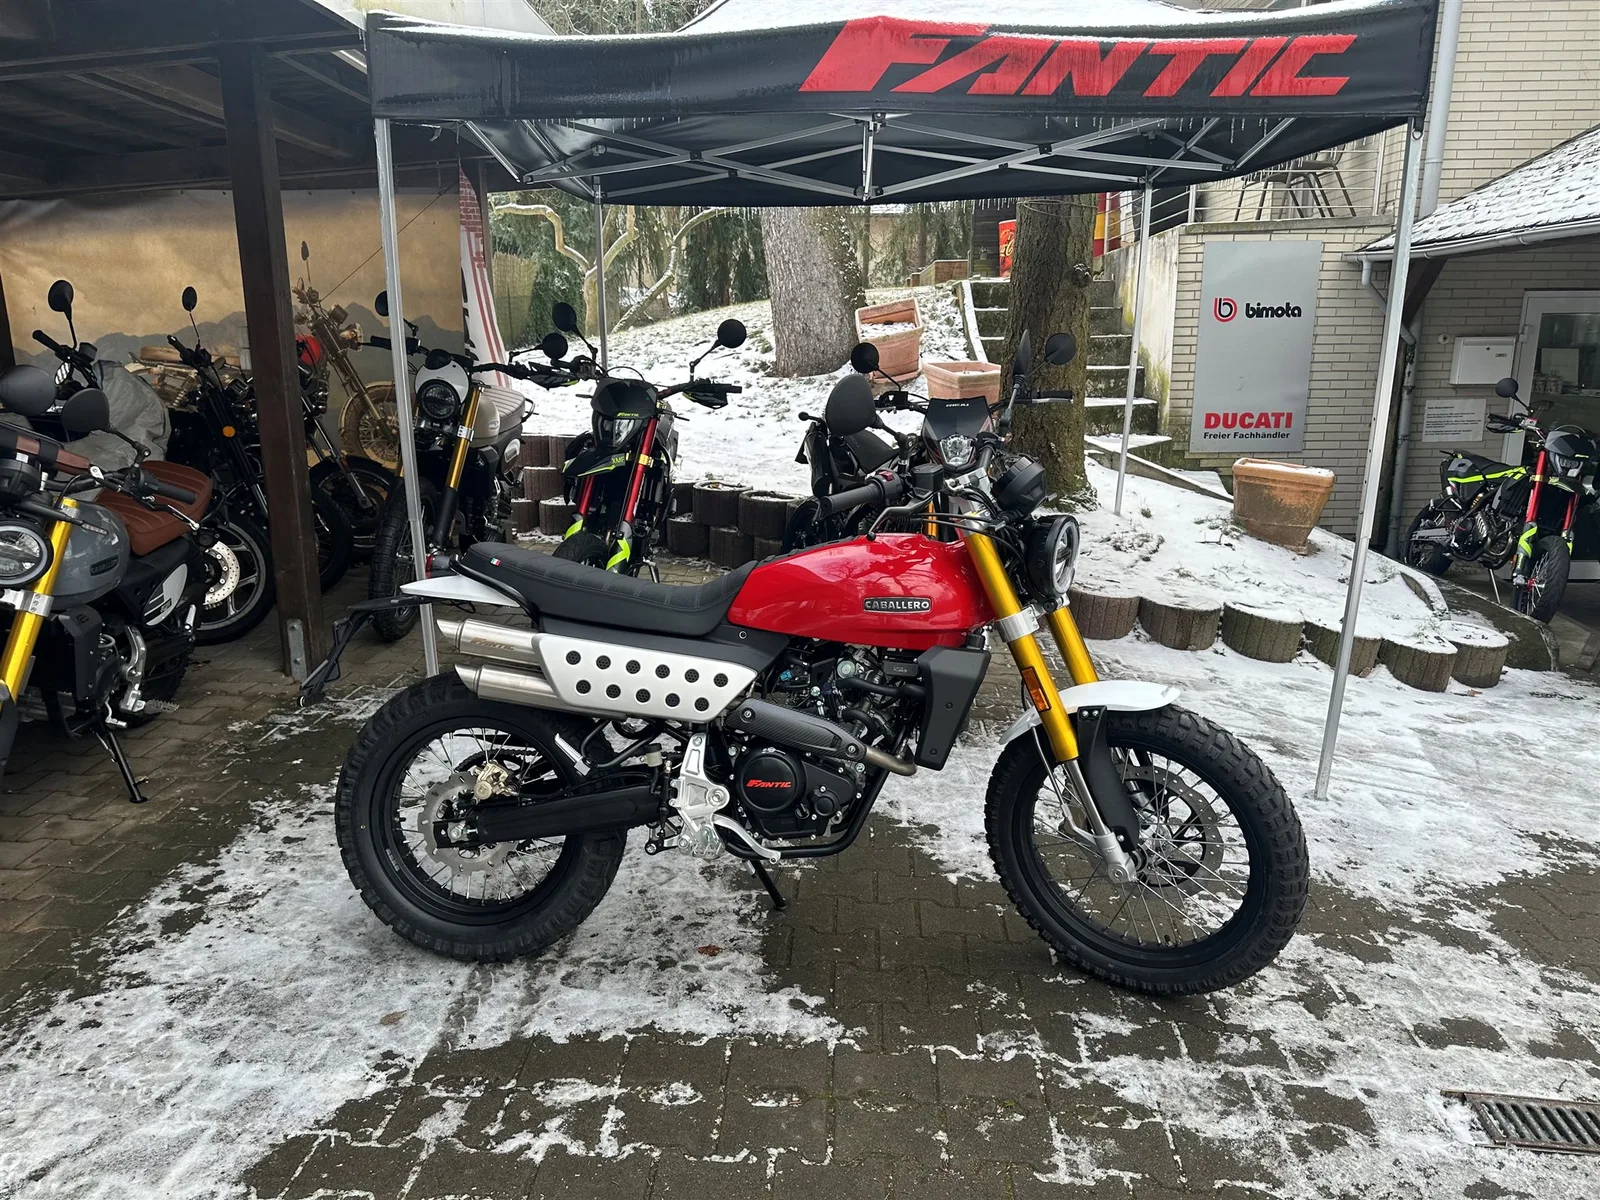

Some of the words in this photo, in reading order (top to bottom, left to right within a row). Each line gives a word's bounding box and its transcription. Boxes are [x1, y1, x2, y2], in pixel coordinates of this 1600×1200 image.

[799, 15, 1357, 97] FANTIC
[1245, 302, 1302, 319] bimota
[1204, 412, 1293, 429] DUCATI
[1203, 431, 1231, 439] Freier
[1233, 431, 1290, 439] Fachhändler
[864, 600, 930, 610] CABALLERO
[470, 636, 515, 651] FANTIC
[746, 779, 792, 788] FANTIC
